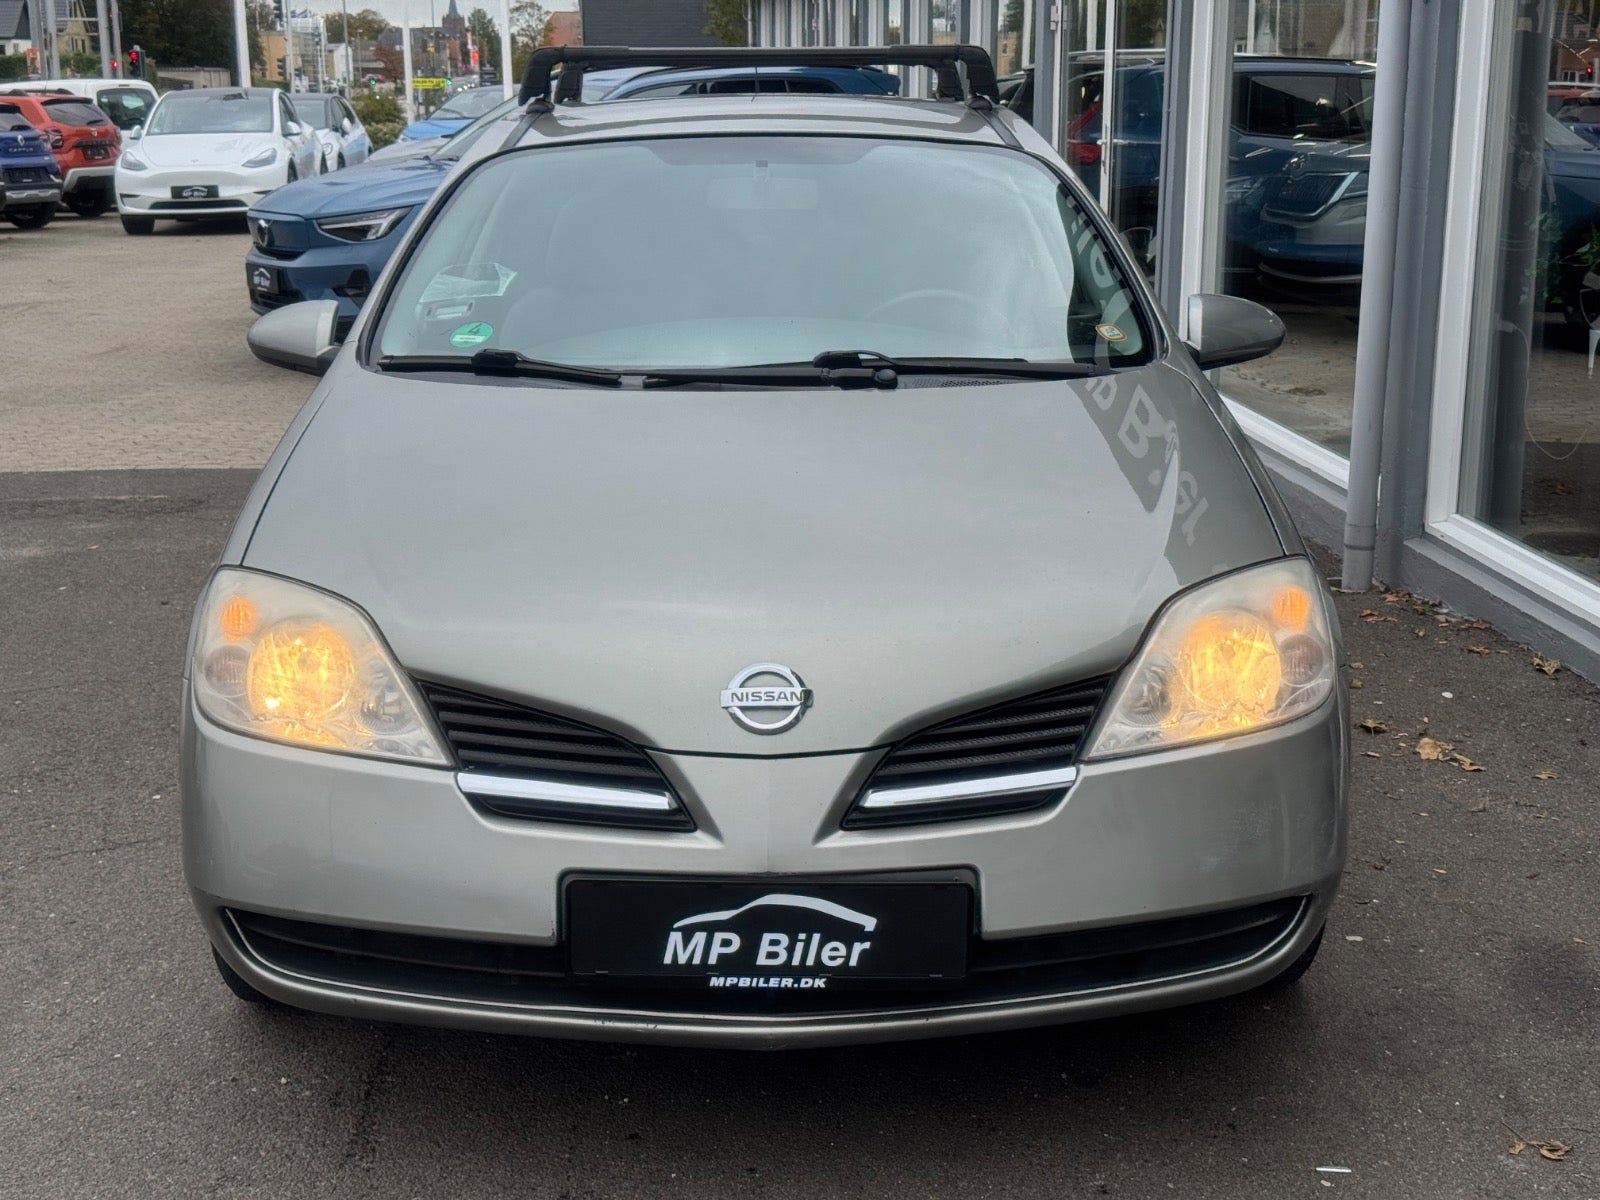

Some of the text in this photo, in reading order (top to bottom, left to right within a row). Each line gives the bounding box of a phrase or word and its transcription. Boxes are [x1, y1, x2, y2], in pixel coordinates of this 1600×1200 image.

[731, 690, 803, 703] NISSAN
[663, 931, 872, 967] MP Biler
[709, 976, 827, 988] MPBILER.DK
